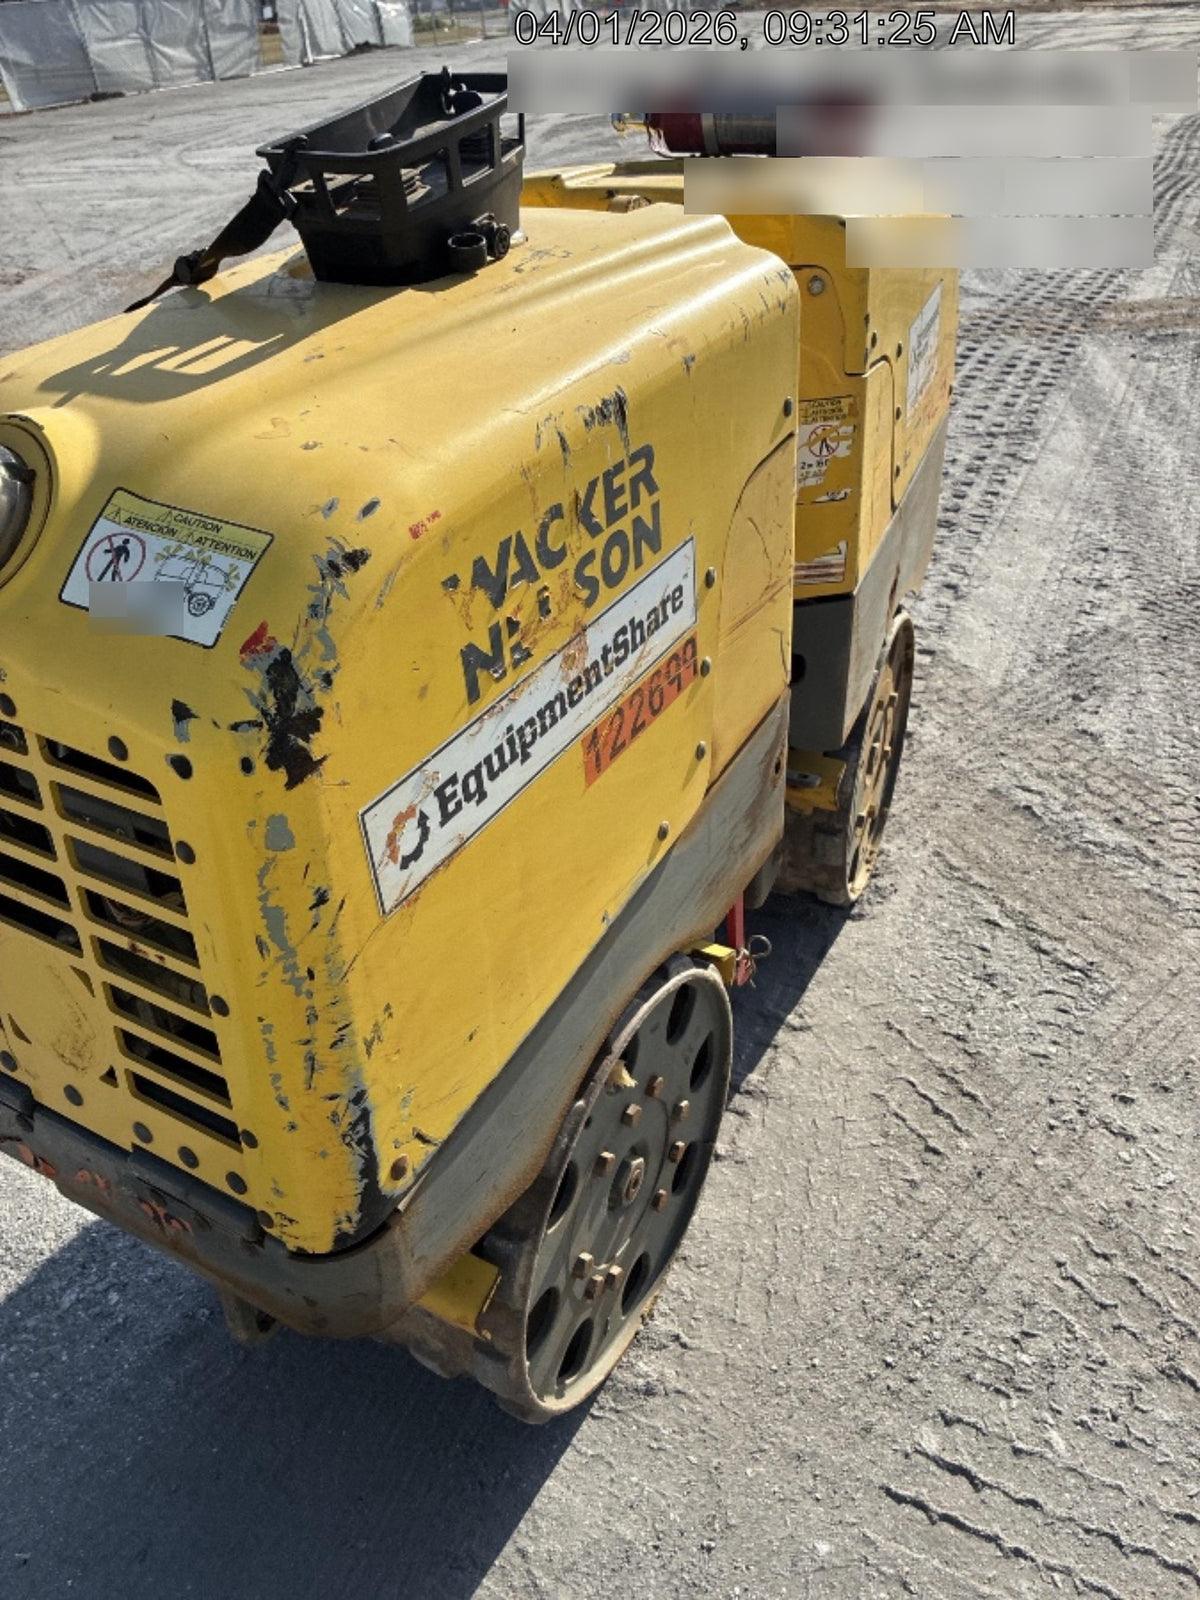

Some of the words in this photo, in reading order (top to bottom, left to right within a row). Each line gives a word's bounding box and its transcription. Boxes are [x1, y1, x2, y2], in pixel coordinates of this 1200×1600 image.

[173, 512, 223, 534] CAUTION
[194, 535, 258, 560] ATTENTION
[442, 443, 661, 611] WACKER
[433, 584, 684, 828] EquipmentShare
[586, 635, 699, 775] 122699
